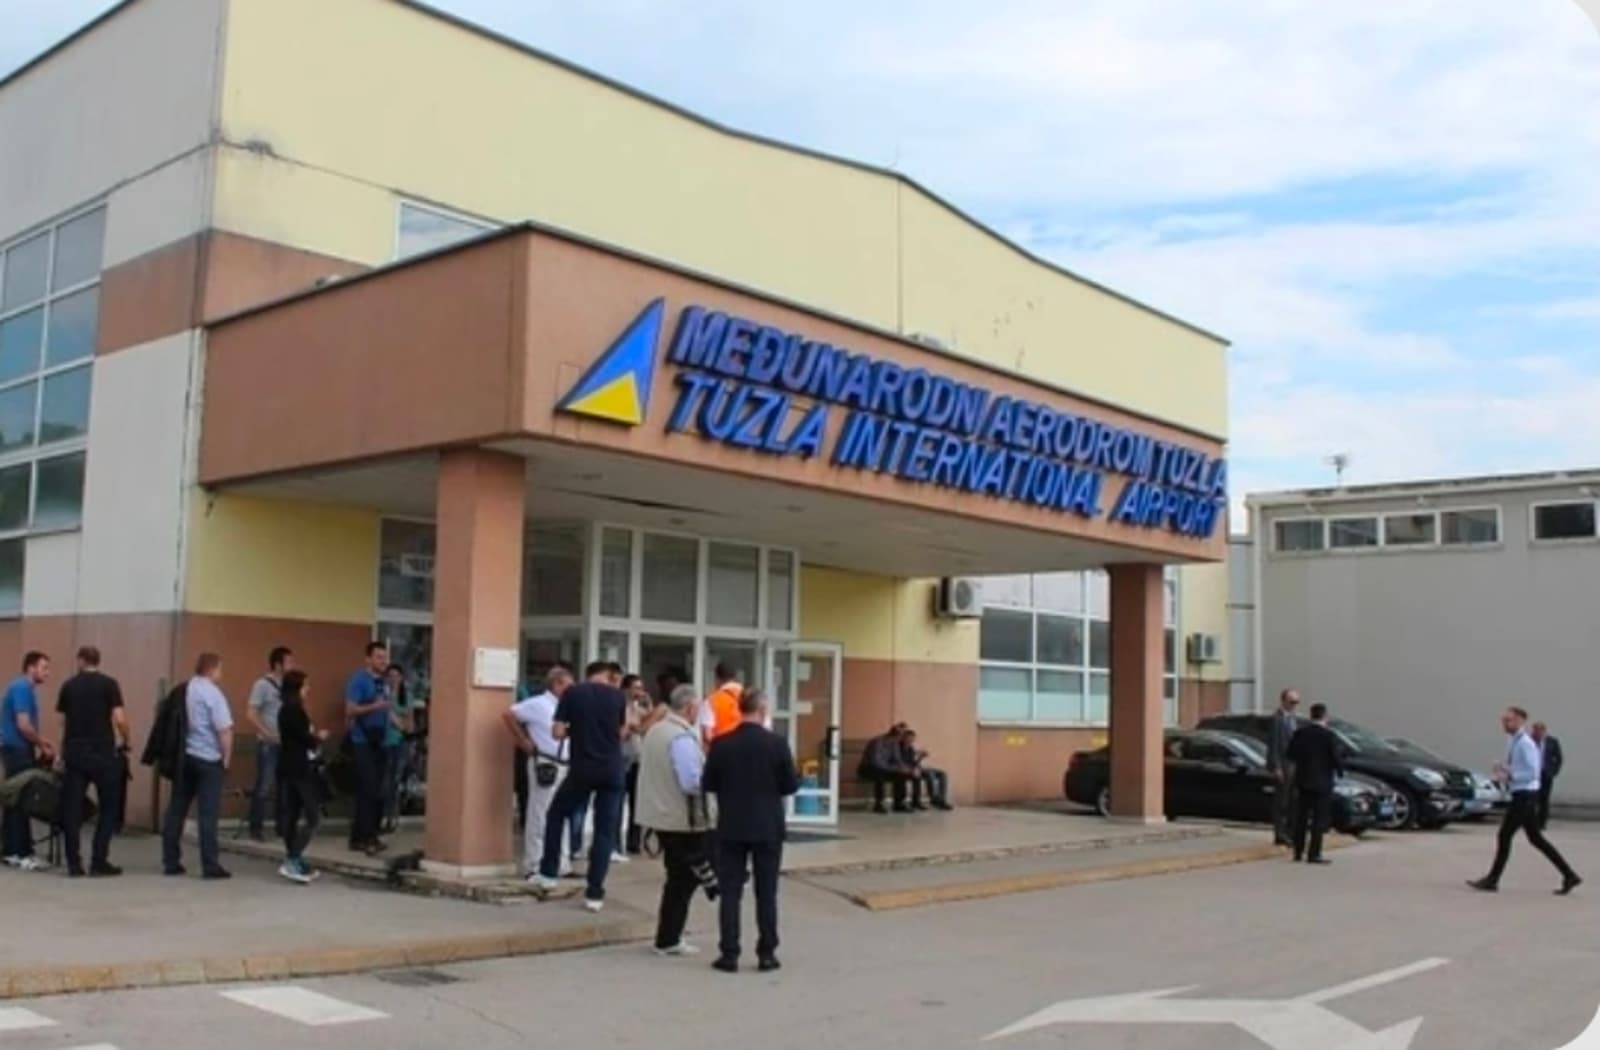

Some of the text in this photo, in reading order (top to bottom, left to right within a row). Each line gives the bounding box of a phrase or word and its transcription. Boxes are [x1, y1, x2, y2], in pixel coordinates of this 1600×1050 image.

[665, 372, 1224, 539] TUZLA INTERNATIONAL AIRPORT
[667, 305, 1227, 499] MEĐUNARODNI AERODROM TUZLA
